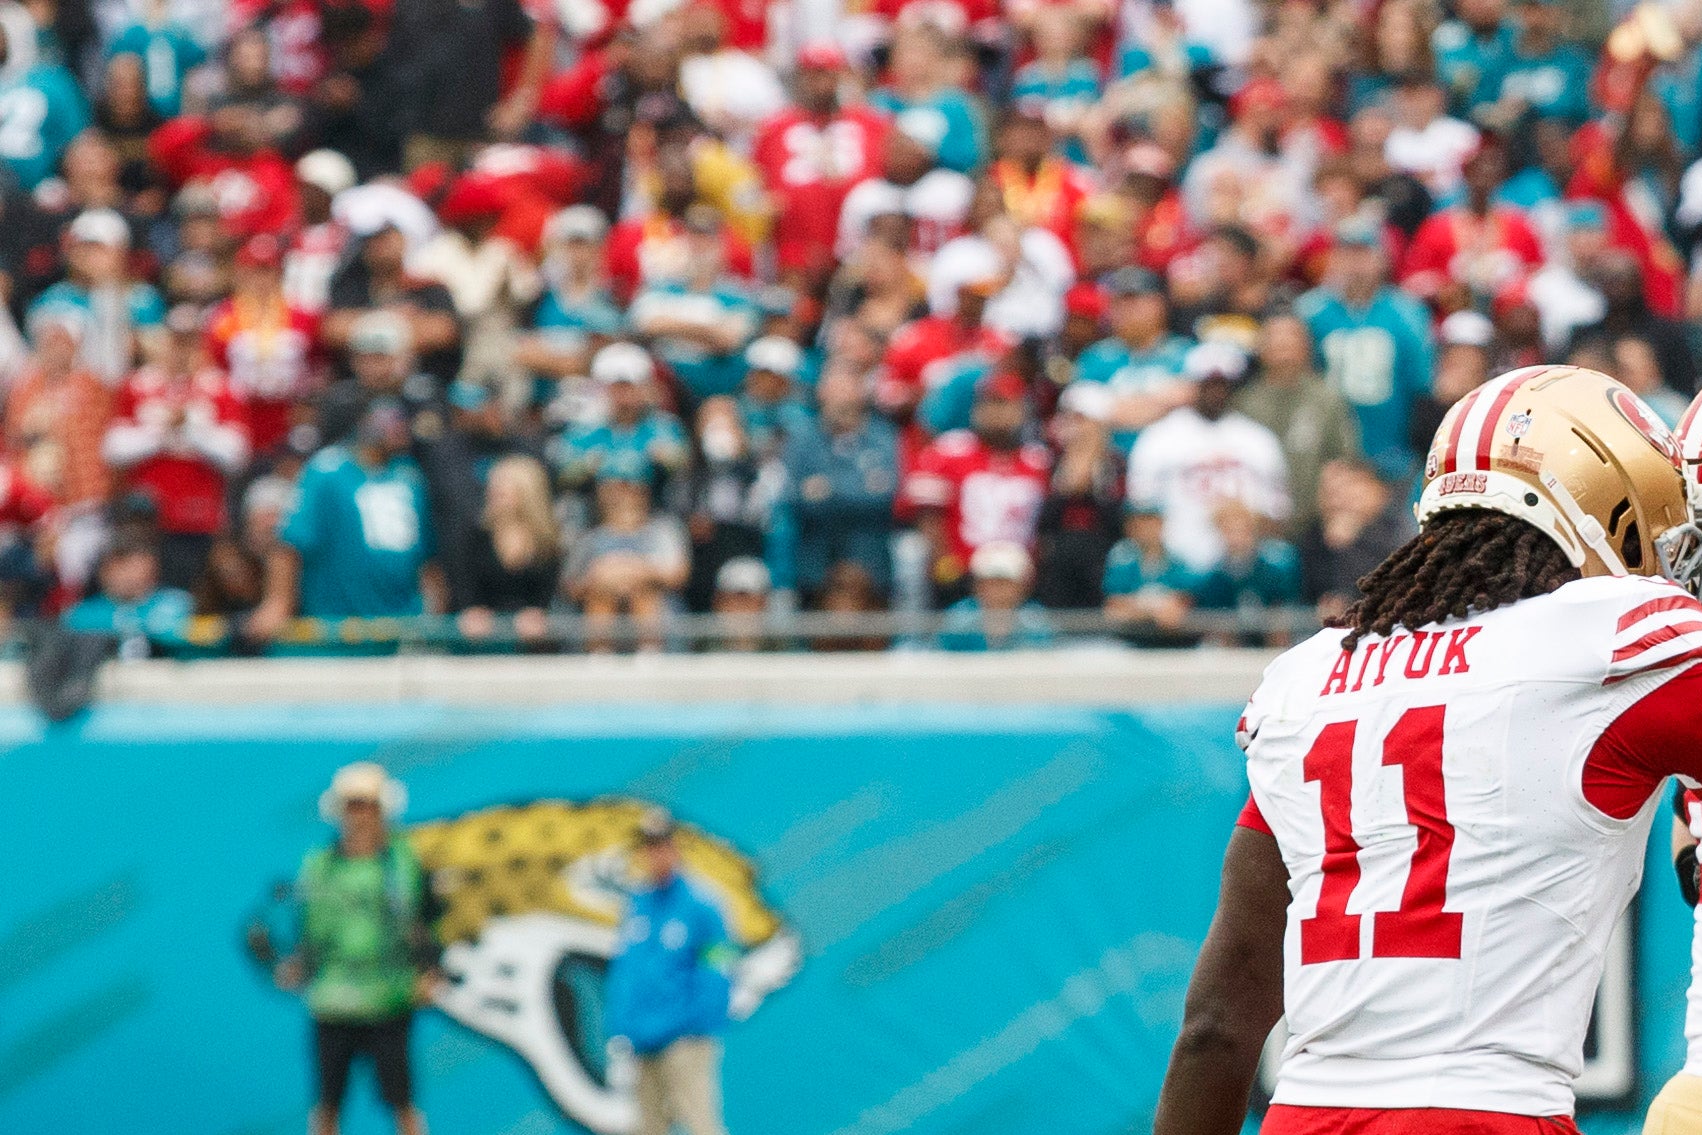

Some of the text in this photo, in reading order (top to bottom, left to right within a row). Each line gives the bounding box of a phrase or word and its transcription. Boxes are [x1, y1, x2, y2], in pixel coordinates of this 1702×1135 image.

[1507, 421, 1527, 437] NFL
[1438, 472, 1488, 497] 49ERS
[1319, 625, 1483, 697] AIYUK
[1300, 703, 1464, 966] 11
